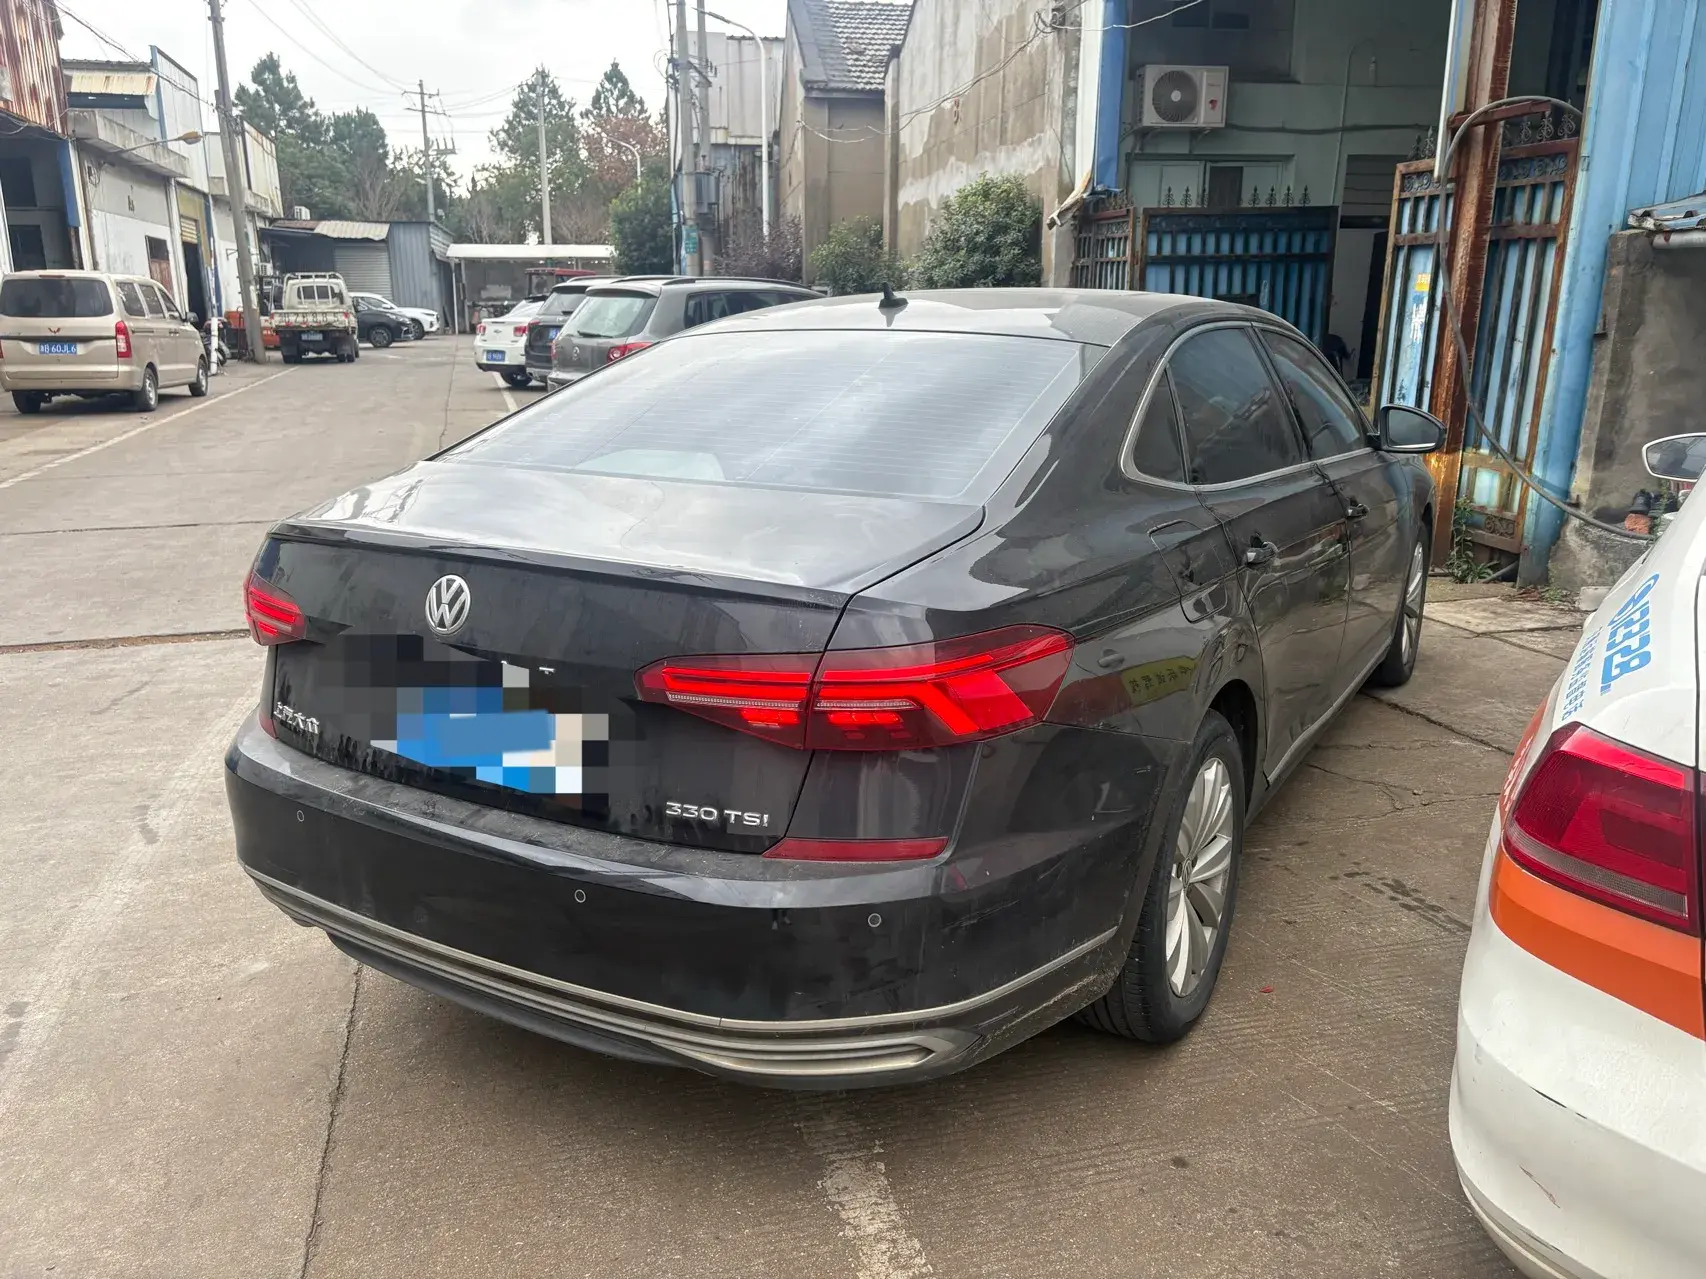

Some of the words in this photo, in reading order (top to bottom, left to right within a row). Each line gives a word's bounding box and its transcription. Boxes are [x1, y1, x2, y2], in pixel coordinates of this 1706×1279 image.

[273, 701, 320, 735] 上汽大众
[665, 801, 718, 821] 330
[723, 809, 769, 828] TSI
